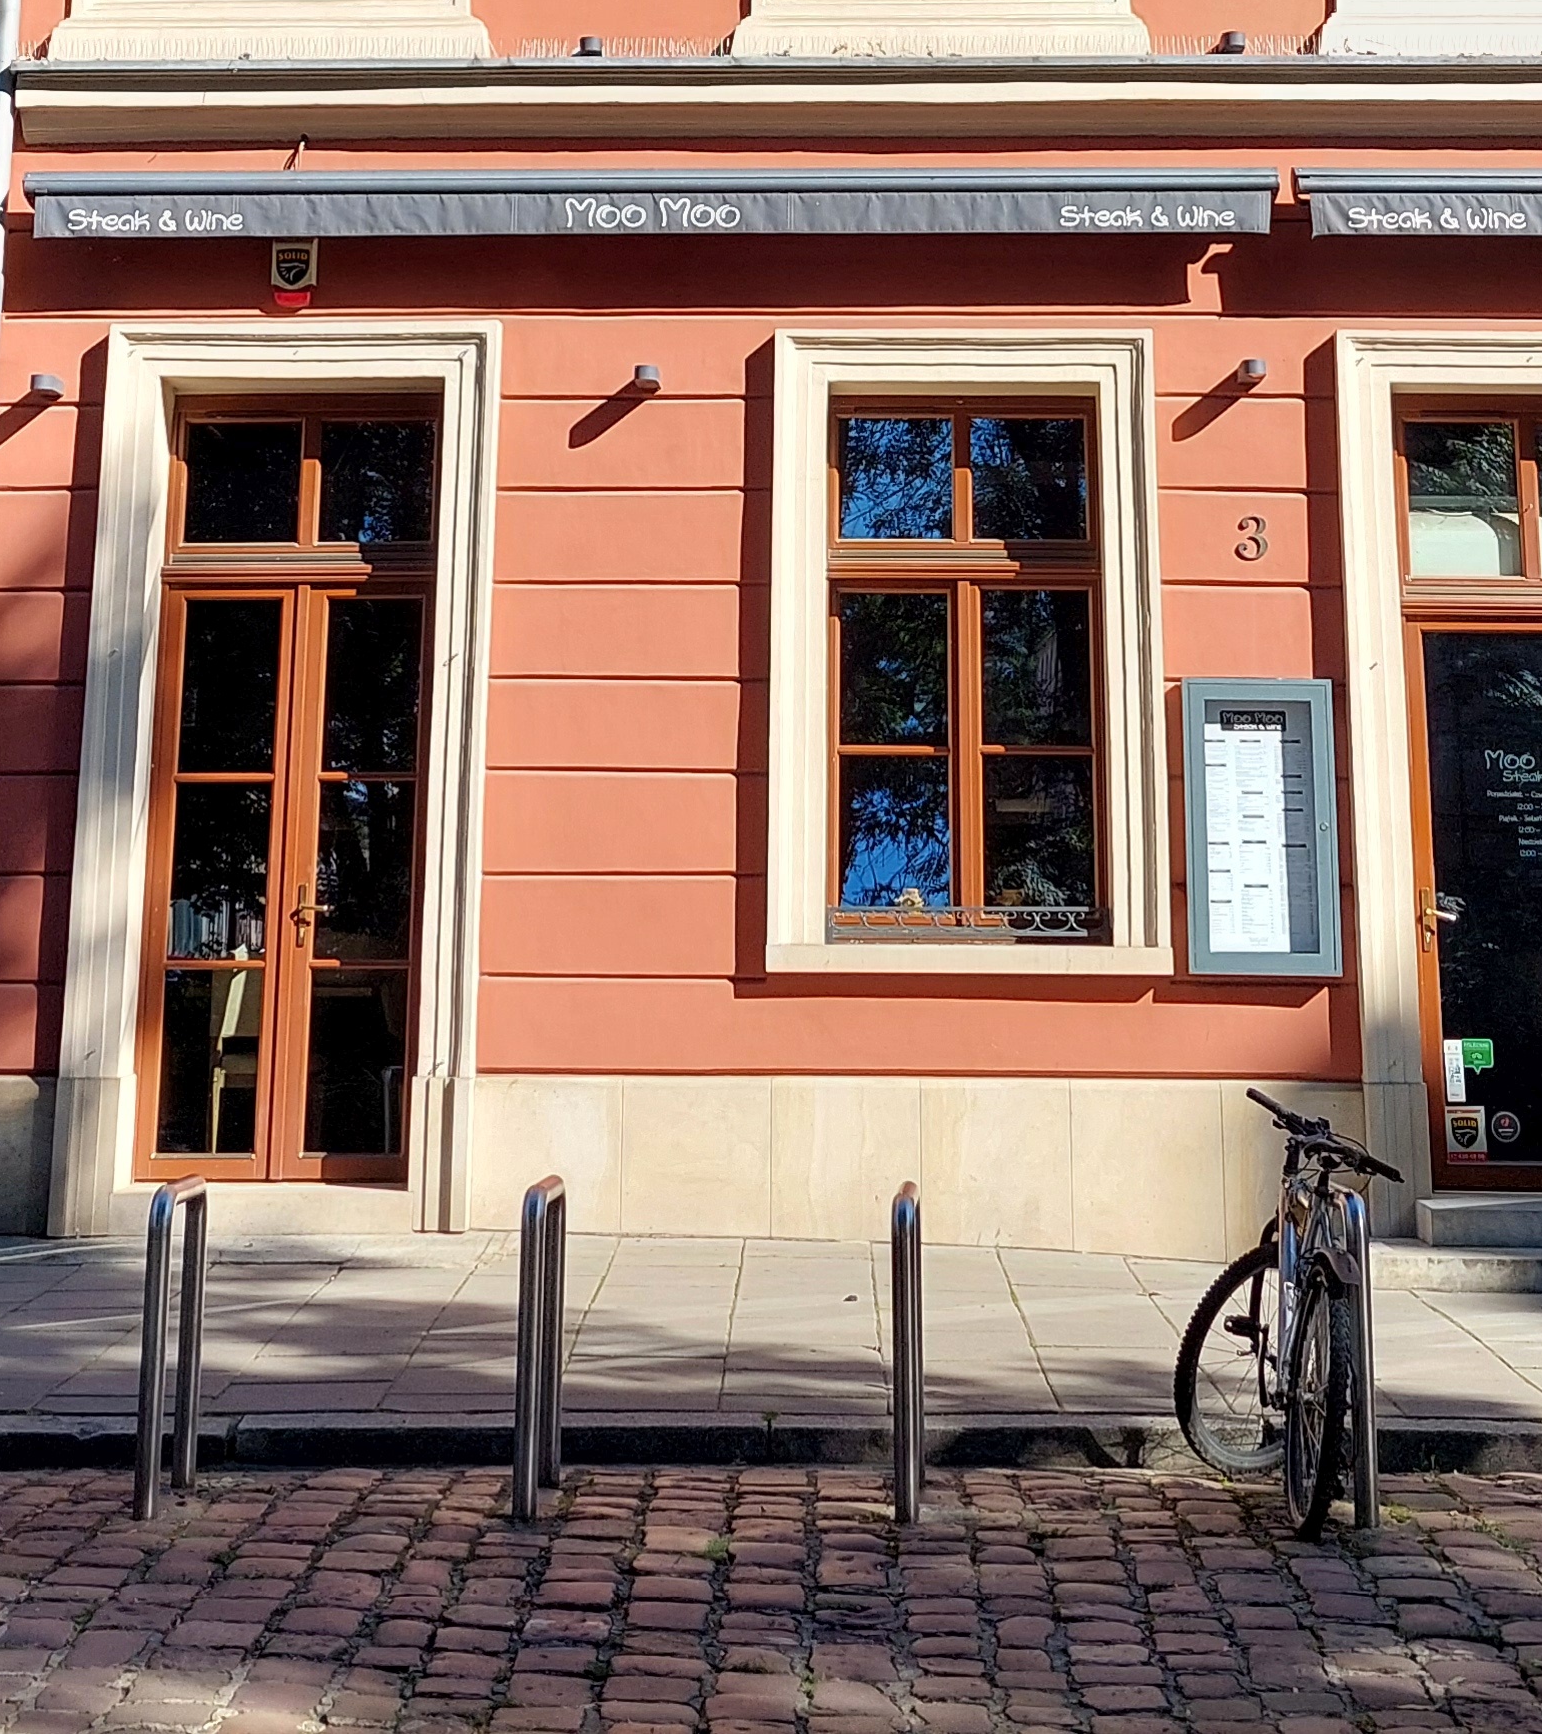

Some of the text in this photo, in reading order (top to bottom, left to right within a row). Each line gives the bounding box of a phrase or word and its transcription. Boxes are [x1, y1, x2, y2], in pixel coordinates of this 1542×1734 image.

[67, 208, 244, 231] Steak & Wine
[565, 197, 741, 228] Moo Moo
[1059, 205, 1236, 227] Steak & Wine
[1348, 206, 1527, 229] Steak & Wine
[278, 251, 308, 261] SOLID
[1234, 516, 1268, 561] 3
[1222, 712, 1283, 723] Moo Moo
[1484, 749, 1535, 769] Moo
[1452, 1119, 1477, 1128] SOLID
